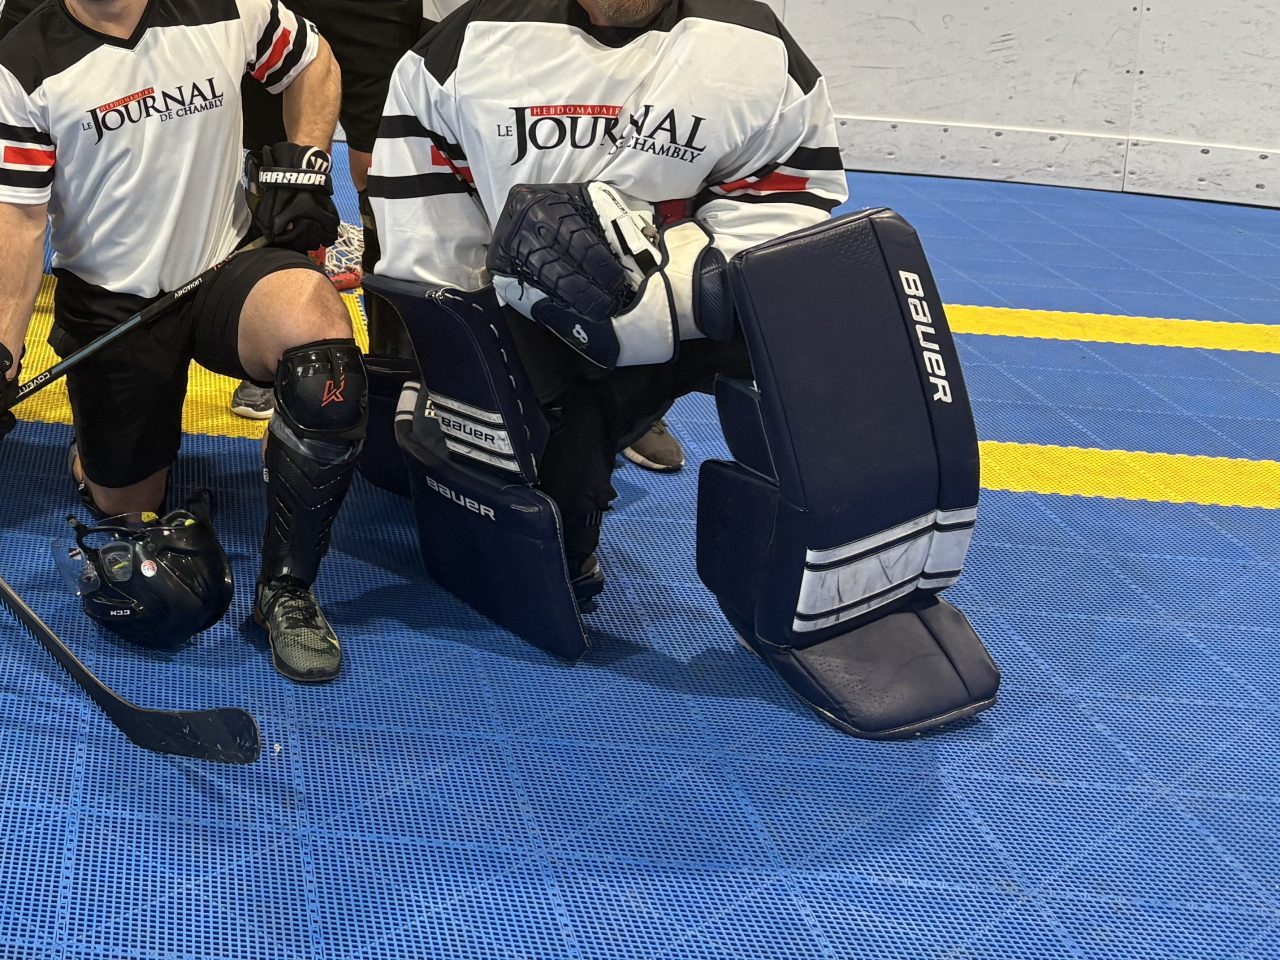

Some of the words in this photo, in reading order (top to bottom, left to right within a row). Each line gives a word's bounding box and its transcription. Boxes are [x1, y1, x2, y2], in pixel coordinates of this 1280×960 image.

[86, 77, 224, 146] JOURNAL
[99, 86, 154, 113] HEBDOMADAIRE
[160, 112, 173, 123] DE
[176, 98, 224, 118] CHAMBLY
[533, 106, 621, 116] HEBDOMADAIR
[81, 122, 93, 131] LE
[497, 124, 514, 137] LE
[259, 171, 327, 186] ARRIOR
[898, 270, 953, 403] BAUER
[441, 416, 496, 444] BAUER
[425, 475, 496, 522] BAUER
